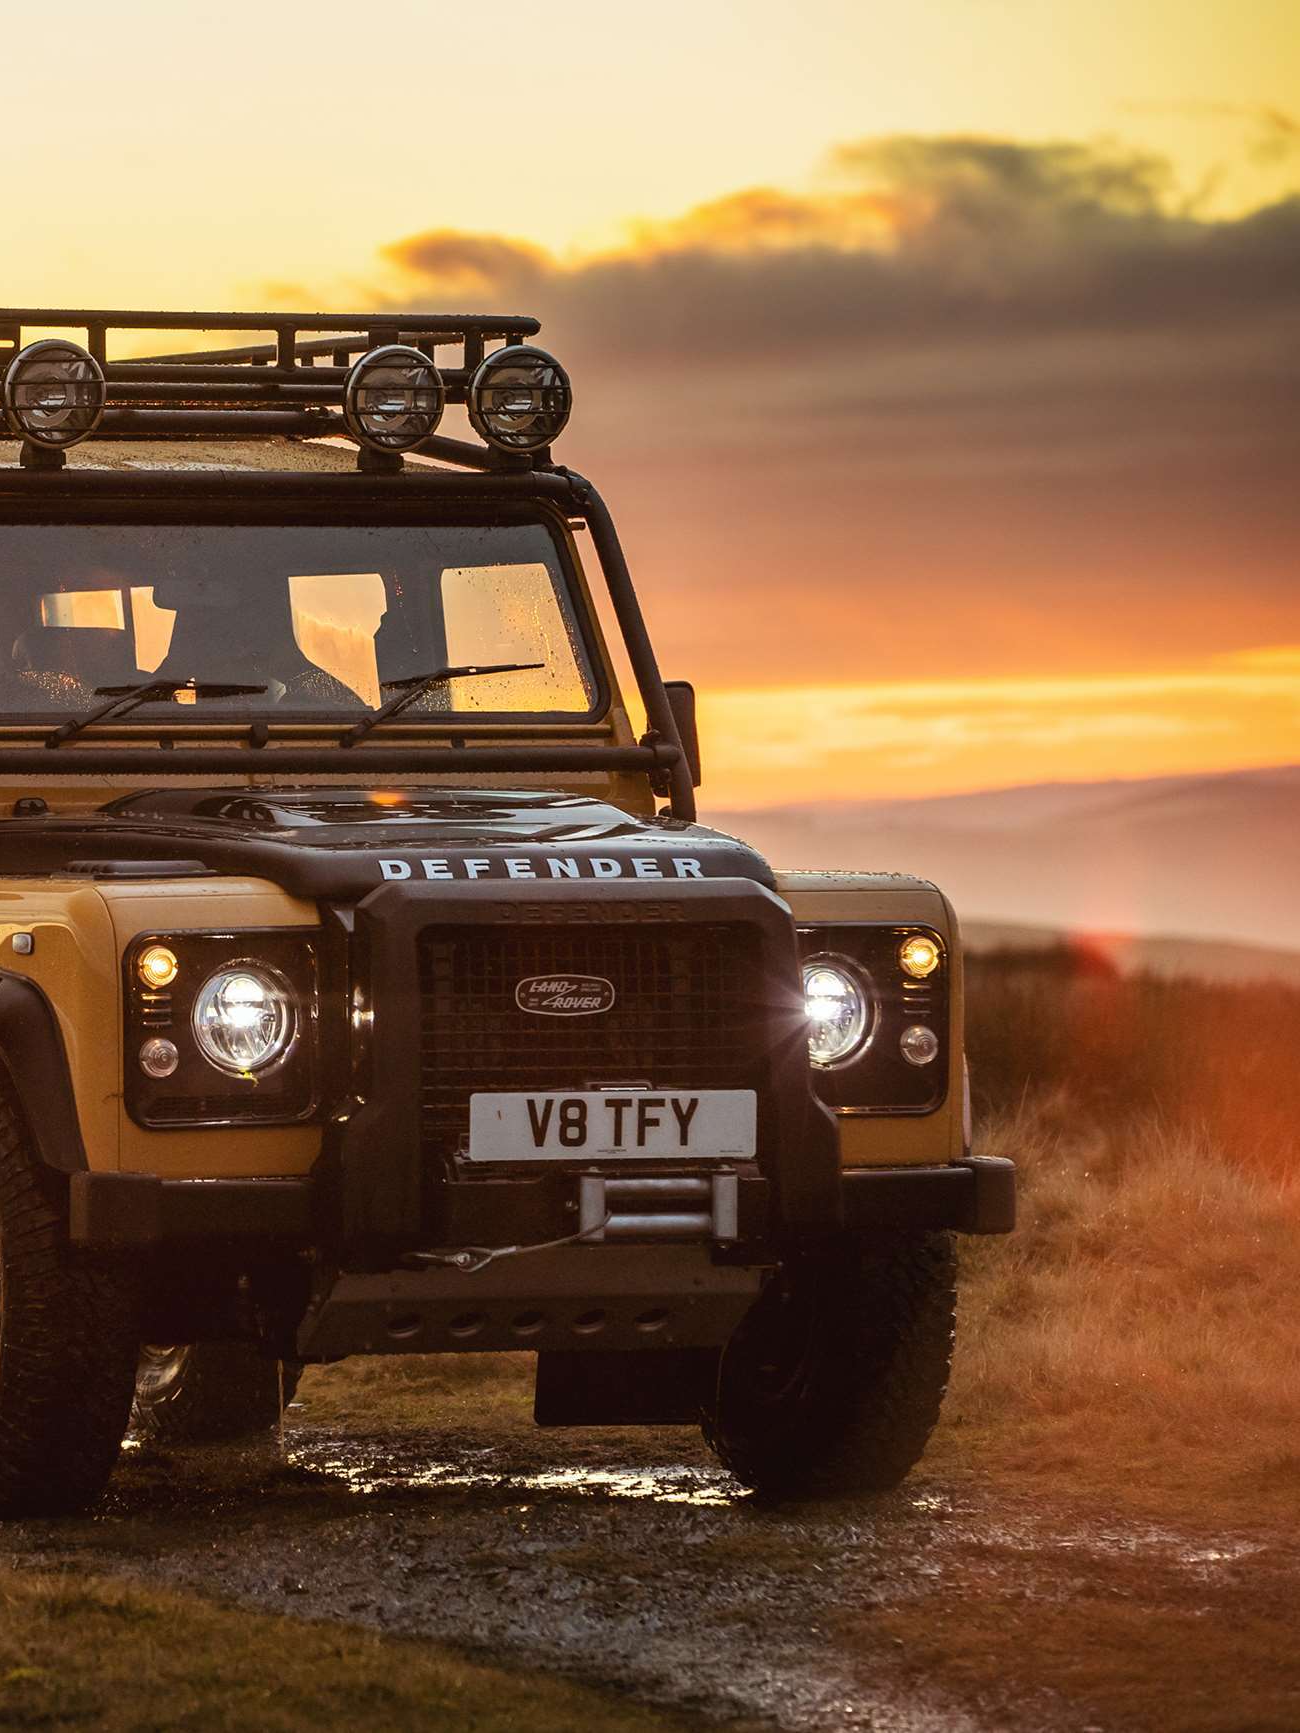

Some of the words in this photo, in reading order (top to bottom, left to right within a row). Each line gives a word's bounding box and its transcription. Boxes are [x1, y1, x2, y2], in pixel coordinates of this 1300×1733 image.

[378, 858, 704, 880] DEFENDER
[529, 981, 570, 993] LAND
[552, 997, 602, 1009] ROVER
[526, 1098, 588, 1147] V8
[604, 1097, 699, 1147] TFY
